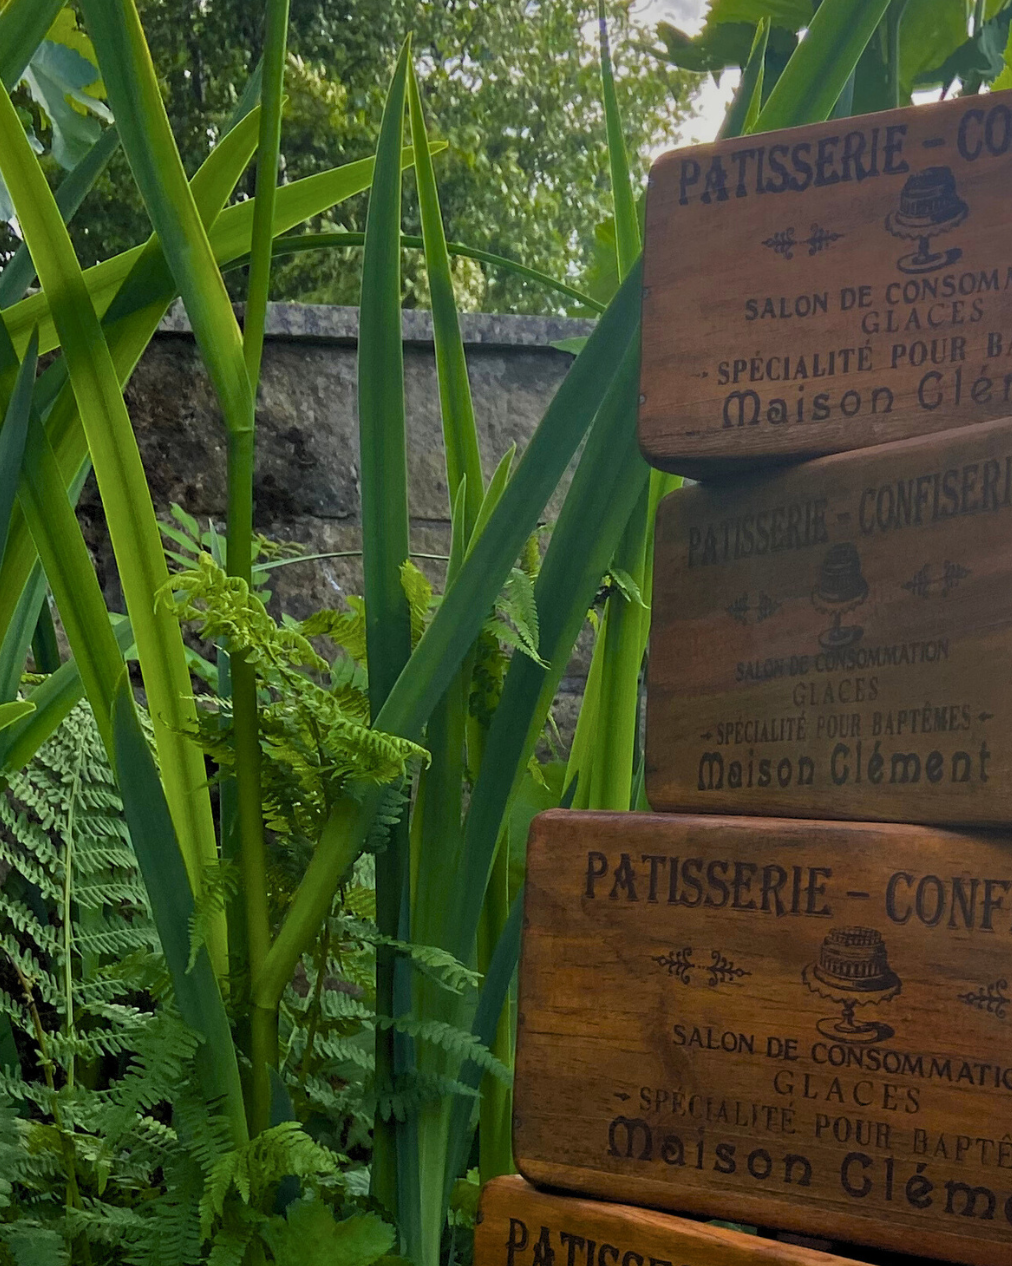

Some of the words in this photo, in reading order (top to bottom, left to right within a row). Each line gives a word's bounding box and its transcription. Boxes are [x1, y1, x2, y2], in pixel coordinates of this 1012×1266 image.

[679, 125, 910, 207] PATISSERIE
[745, 292, 829, 321] SALON
[840, 285, 873, 310] DE
[861, 299, 985, 335] GLACES
[717, 340, 873, 386] SPÉCIALITÉ
[892, 335, 967, 365] POUR
[722, 387, 894, 428] Maison
[688, 498, 829, 568] PATISSERIE
[736, 658, 784, 683] SALON
[789, 655, 809, 677] DE
[814, 639, 949, 674] CONSOMMATION
[793, 677, 879, 707] GLACES
[716, 708, 807, 746] SPÉCIALITÉ
[817, 712, 863, 738] POUR
[872, 700, 971, 735] BAPTÊMES
[698, 751, 814, 791] Maison
[829, 741, 992, 786] Clément
[585, 851, 832, 918] PATISSERIE
[672, 1024, 754, 1055] SALON
[767, 1036, 798, 1061] DE
[773, 1070, 921, 1114] GLACES
[639, 1084, 796, 1136] SPÉCIALITÉ
[815, 1113, 892, 1150] POUR
[607, 1115, 812, 1187] Maison
